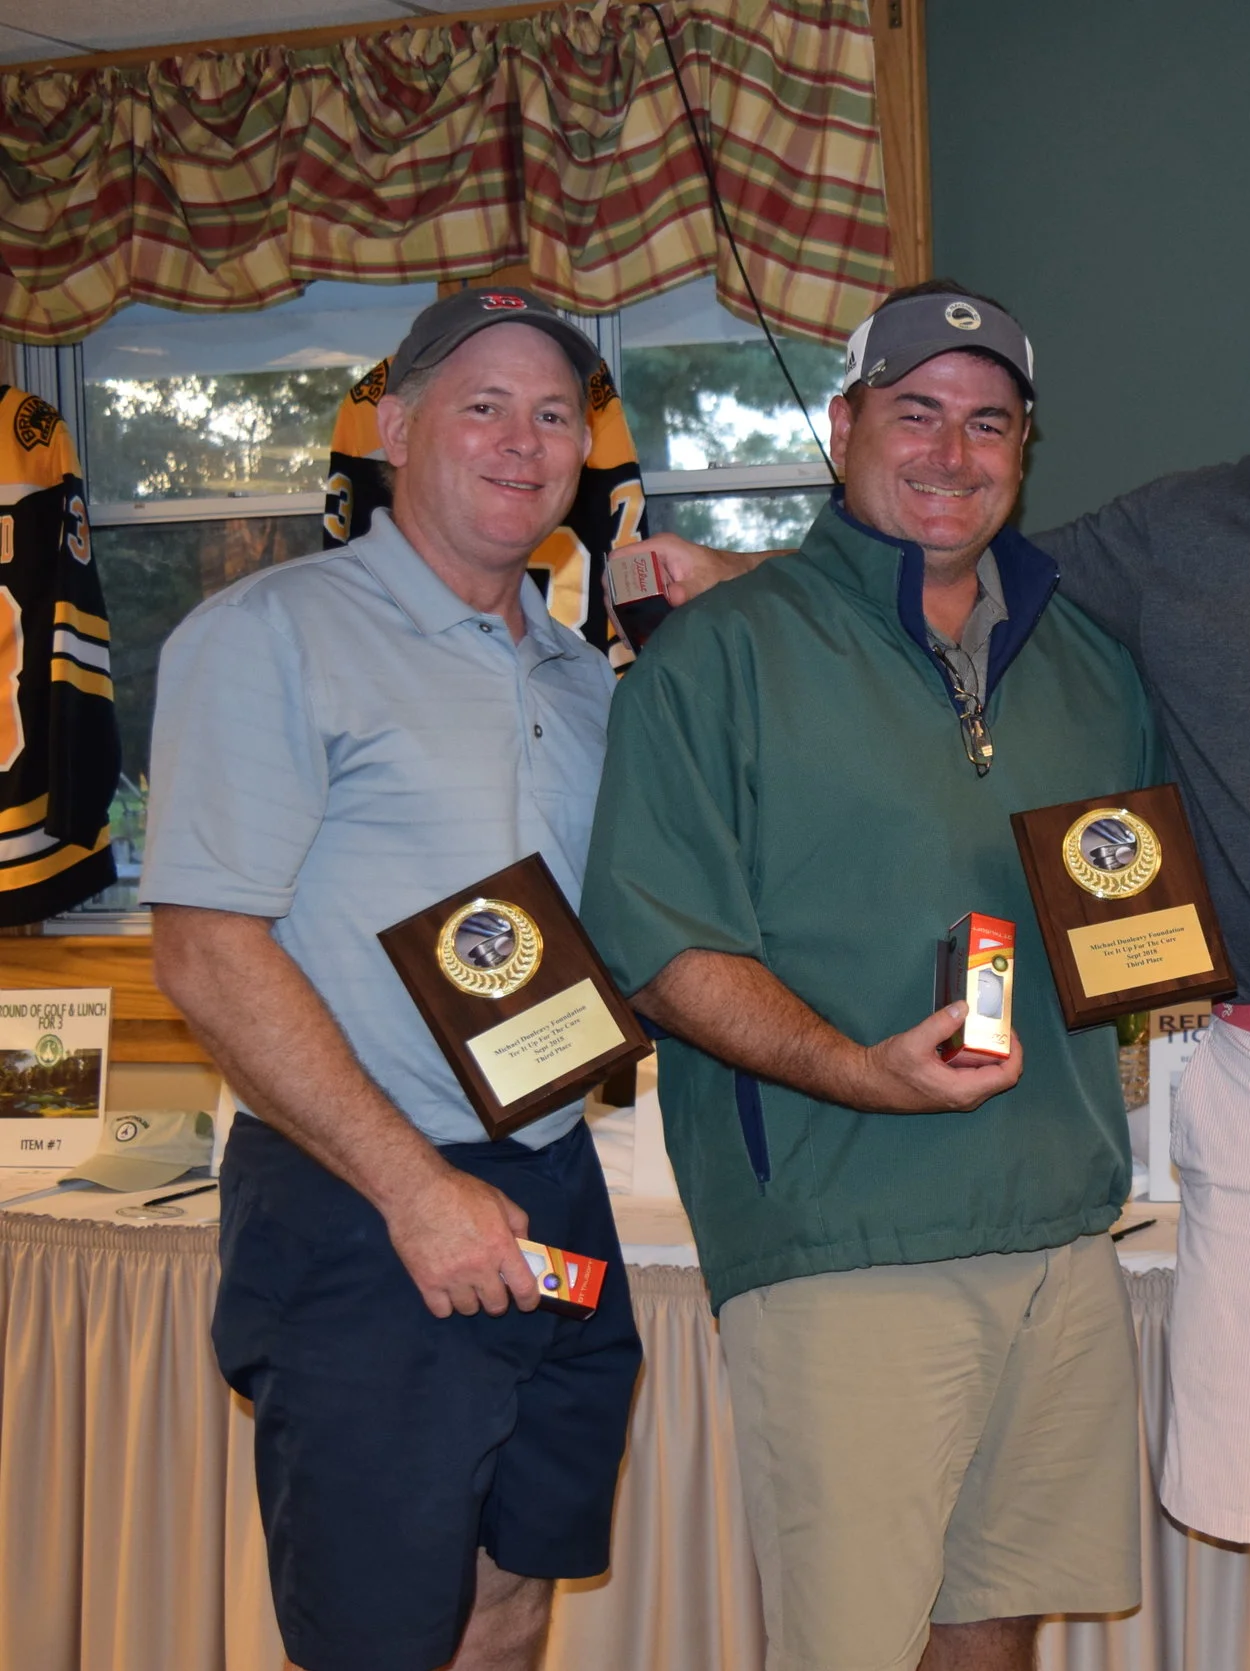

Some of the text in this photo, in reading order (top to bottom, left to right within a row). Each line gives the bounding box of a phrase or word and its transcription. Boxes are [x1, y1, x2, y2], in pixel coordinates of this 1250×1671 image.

[1090, 927, 1185, 951] Michael Dunleavy Foundation
[1127, 949, 1157, 960] Sept 2018
[1127, 960, 1144, 968] Third
[0, 1003, 107, 1017] OUND OF GOLF & LUNCH
[39, 1016, 63, 1029] FOR 3
[494, 1005, 587, 1055] Michael Dunleavy Foundation
[509, 1049, 521, 1058] Tee
[528, 1040, 539, 1049] Up
[551, 1027, 564, 1036] The
[565, 1018, 580, 1029] Cure
[534, 1045, 549, 1055] Sept
[536, 1043, 572, 1063] Third Place
[20, 1139, 43, 1150] ITEM
